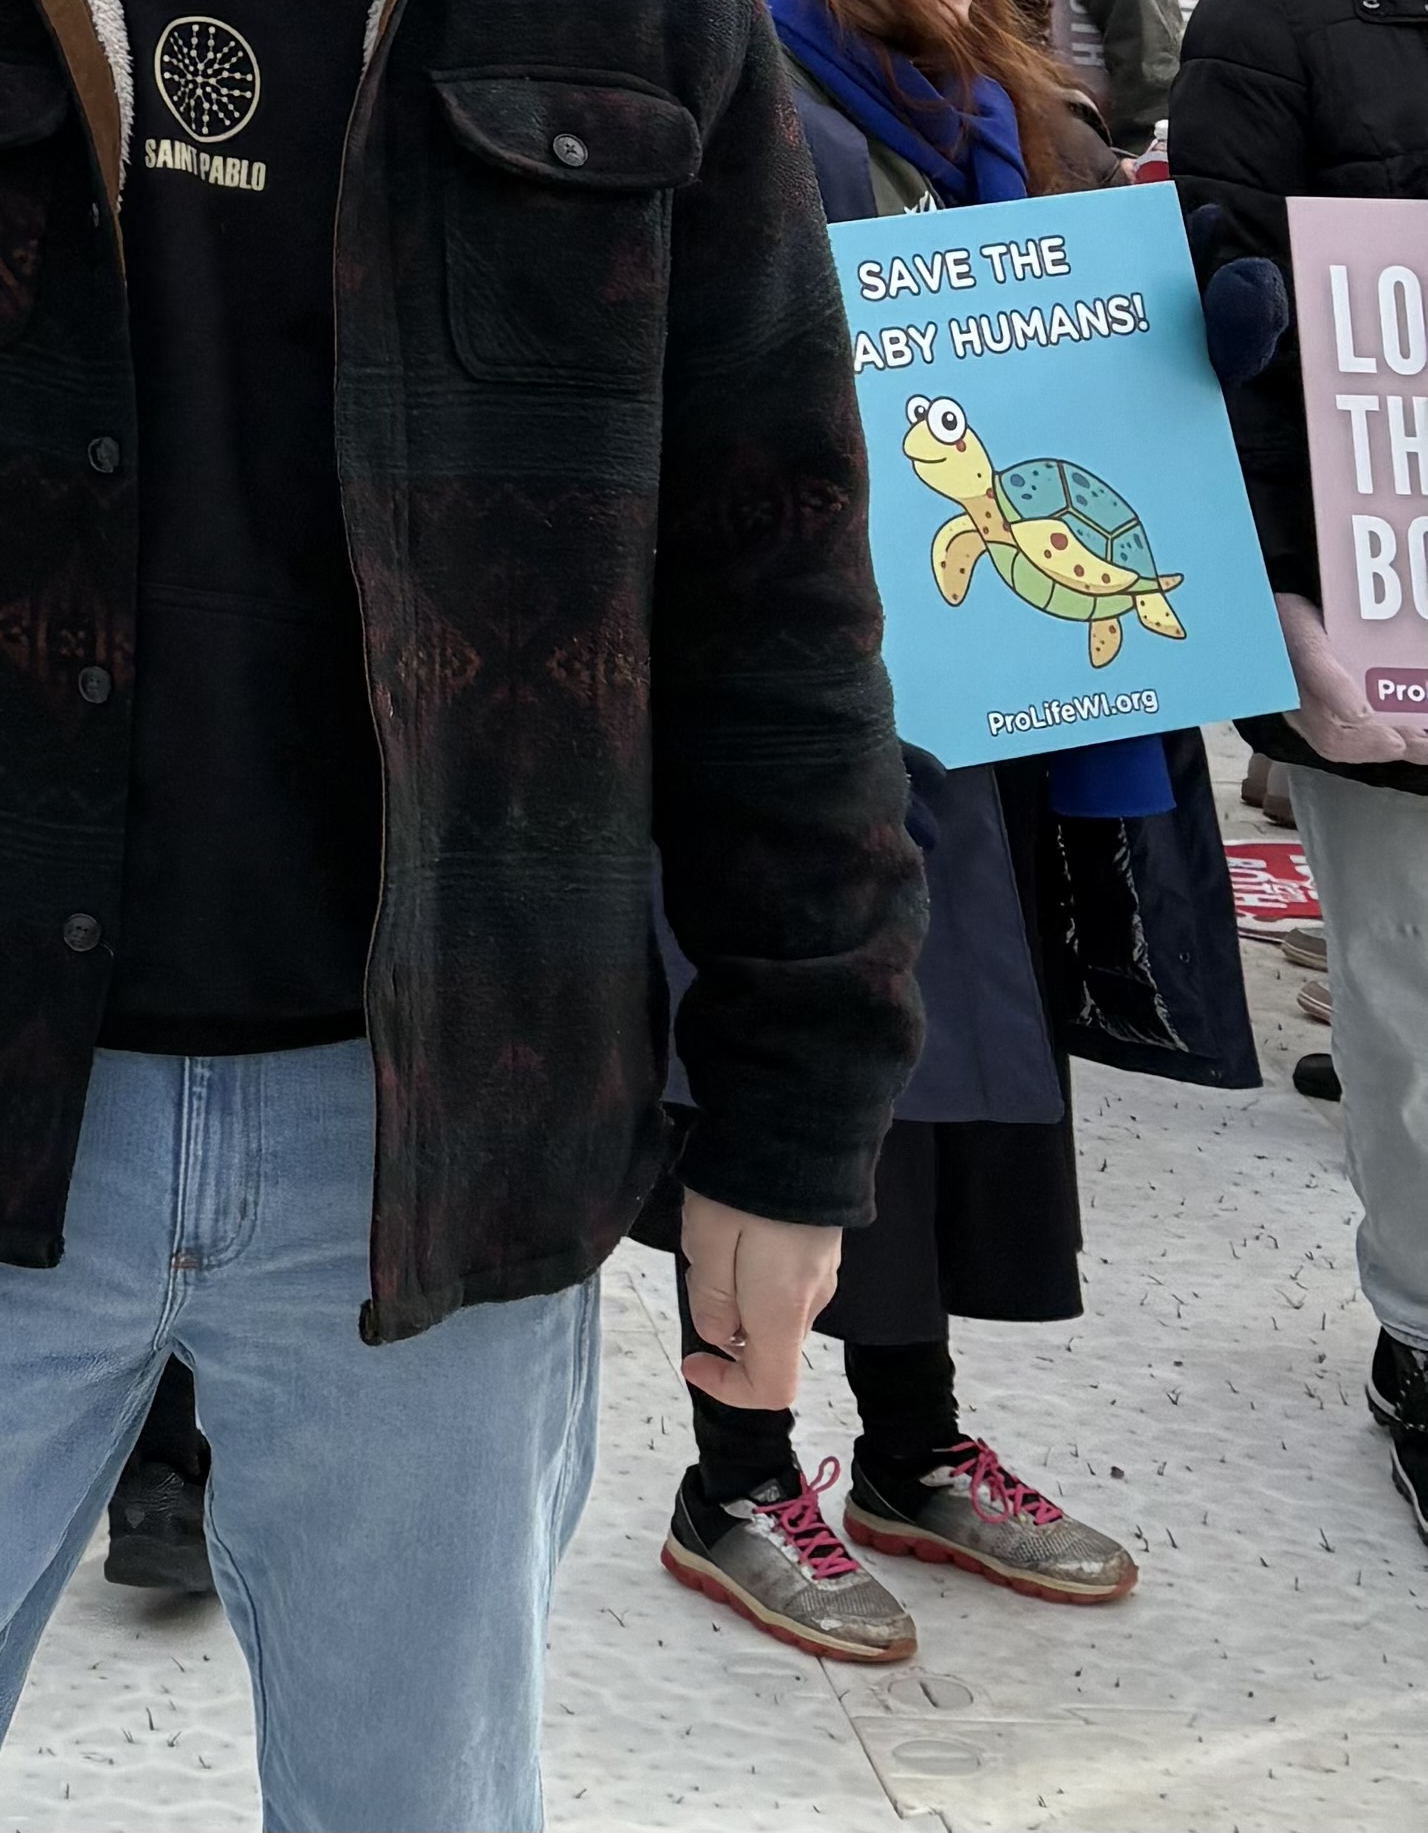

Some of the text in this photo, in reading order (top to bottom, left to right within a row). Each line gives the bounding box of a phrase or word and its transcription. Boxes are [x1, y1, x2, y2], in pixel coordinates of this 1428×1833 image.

[145, 138, 266, 191] SAINT PABLO
[857, 235, 1071, 301] SAVE THE
[853, 292, 1150, 374] ABY HUMANS!
[1329, 265, 1428, 376] LO
[1336, 394, 1428, 496] TH
[987, 689, 1159, 736] ProLifeWI.org
[1377, 678, 1428, 703] Pro
